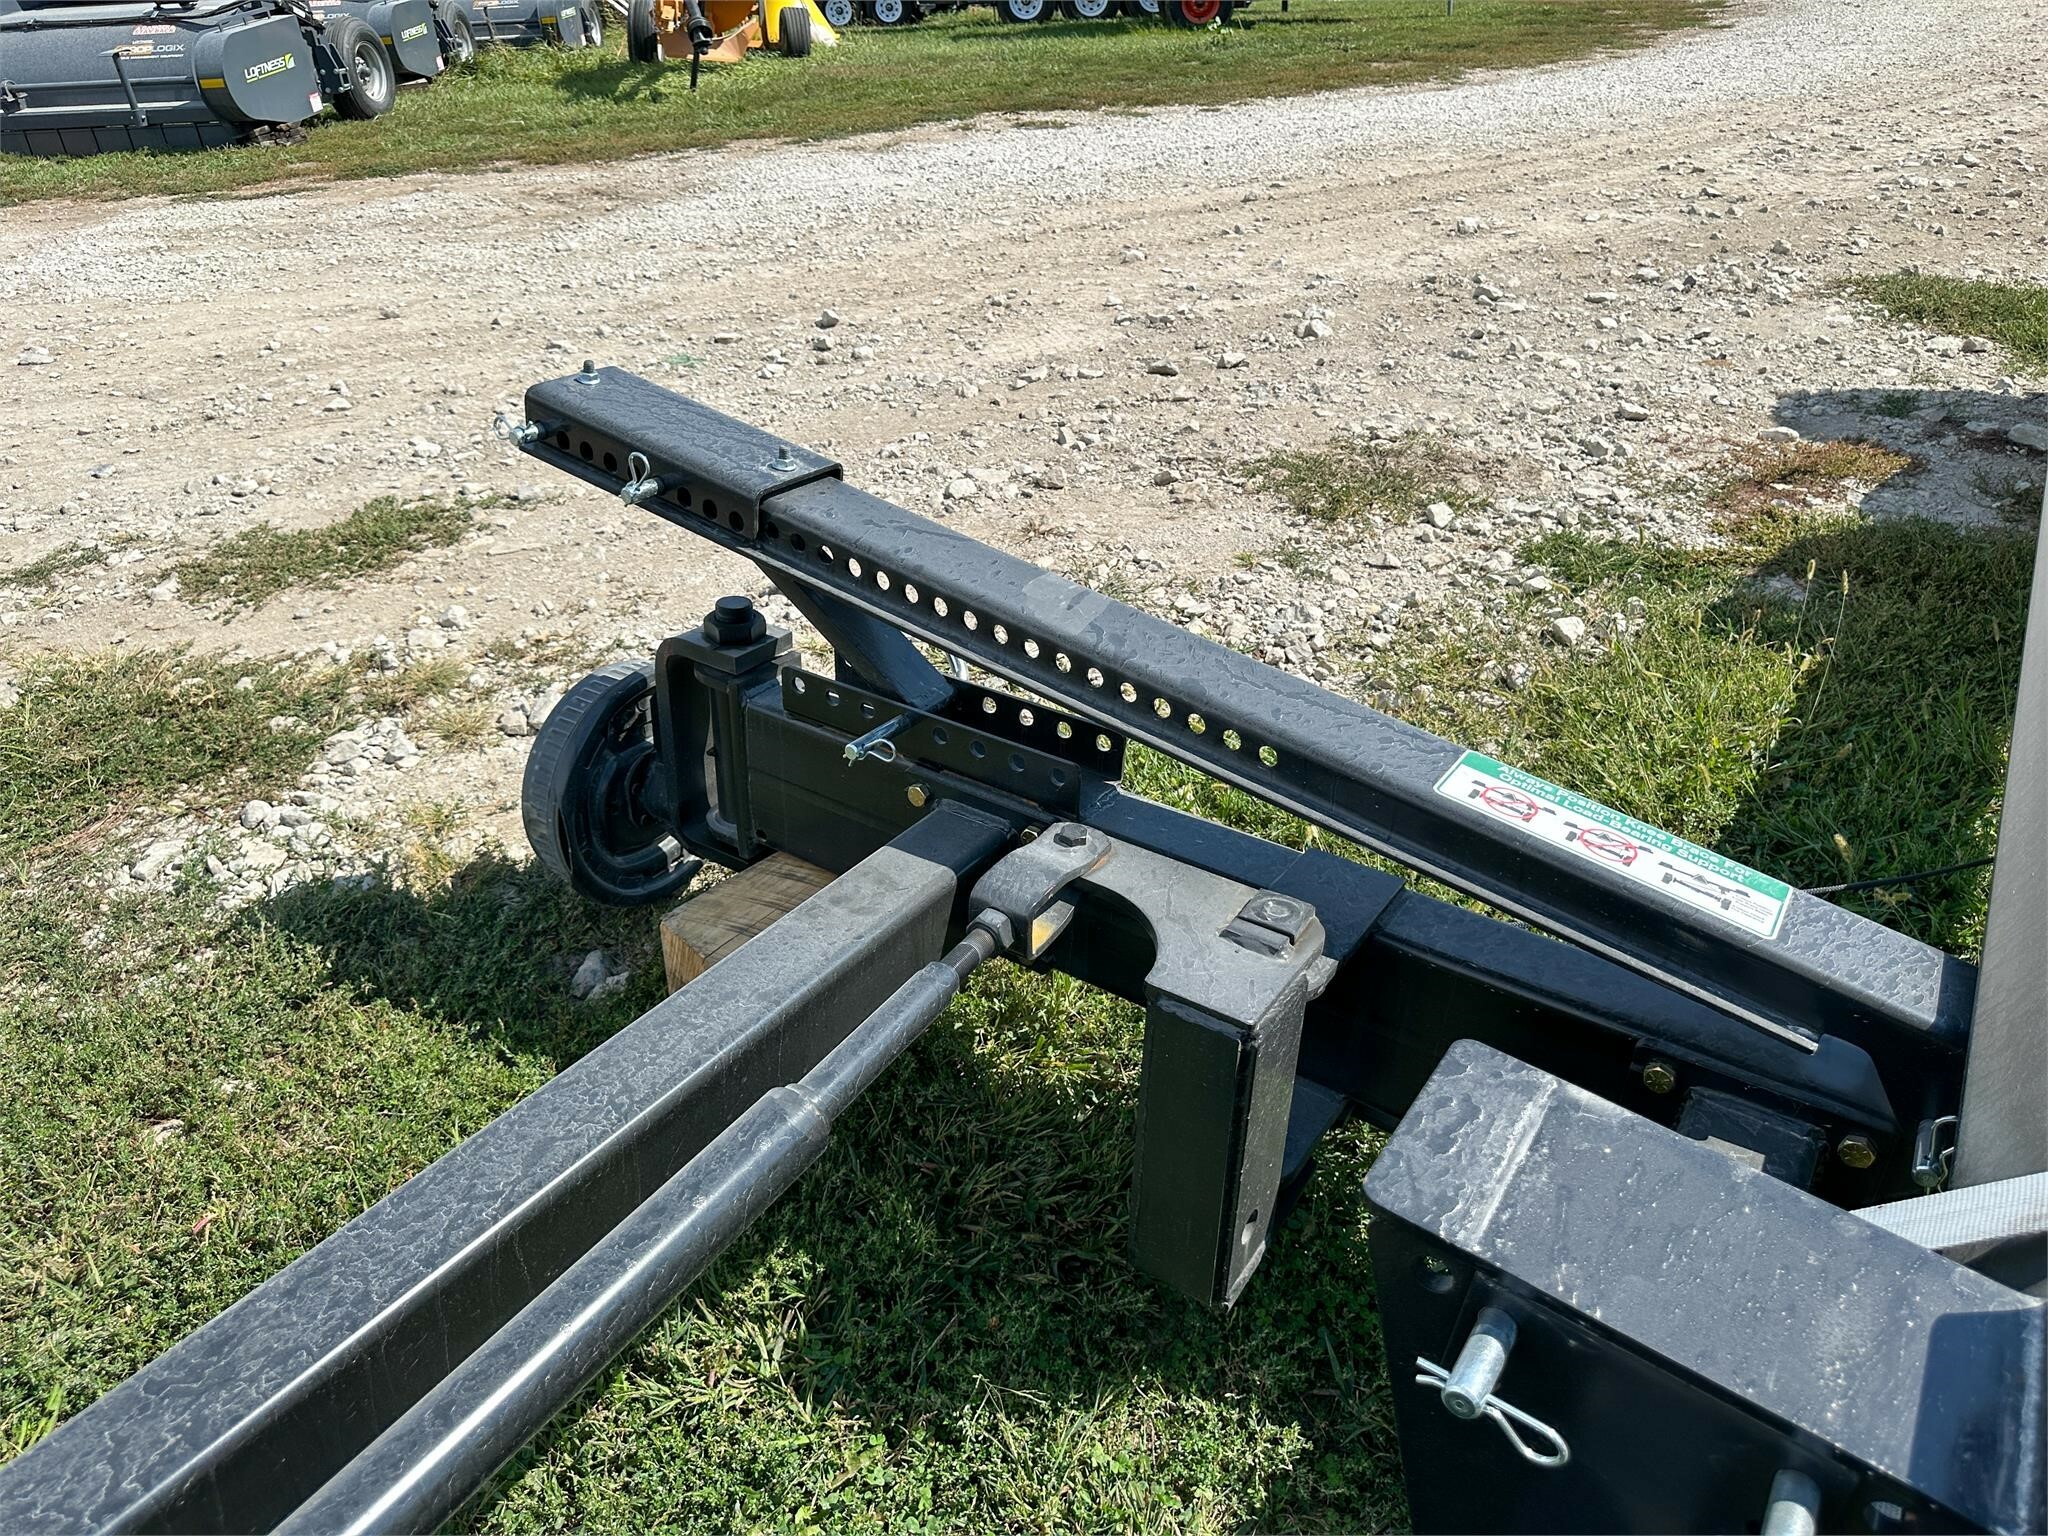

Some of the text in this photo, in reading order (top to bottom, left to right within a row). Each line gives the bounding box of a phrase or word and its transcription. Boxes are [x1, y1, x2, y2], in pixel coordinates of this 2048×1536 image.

[244, 57, 286, 79] LOFTNESS
[1497, 765, 1753, 878] Always Position Knee Brace For
[1500, 773, 1746, 883] Optimal Load-Bearing Support
